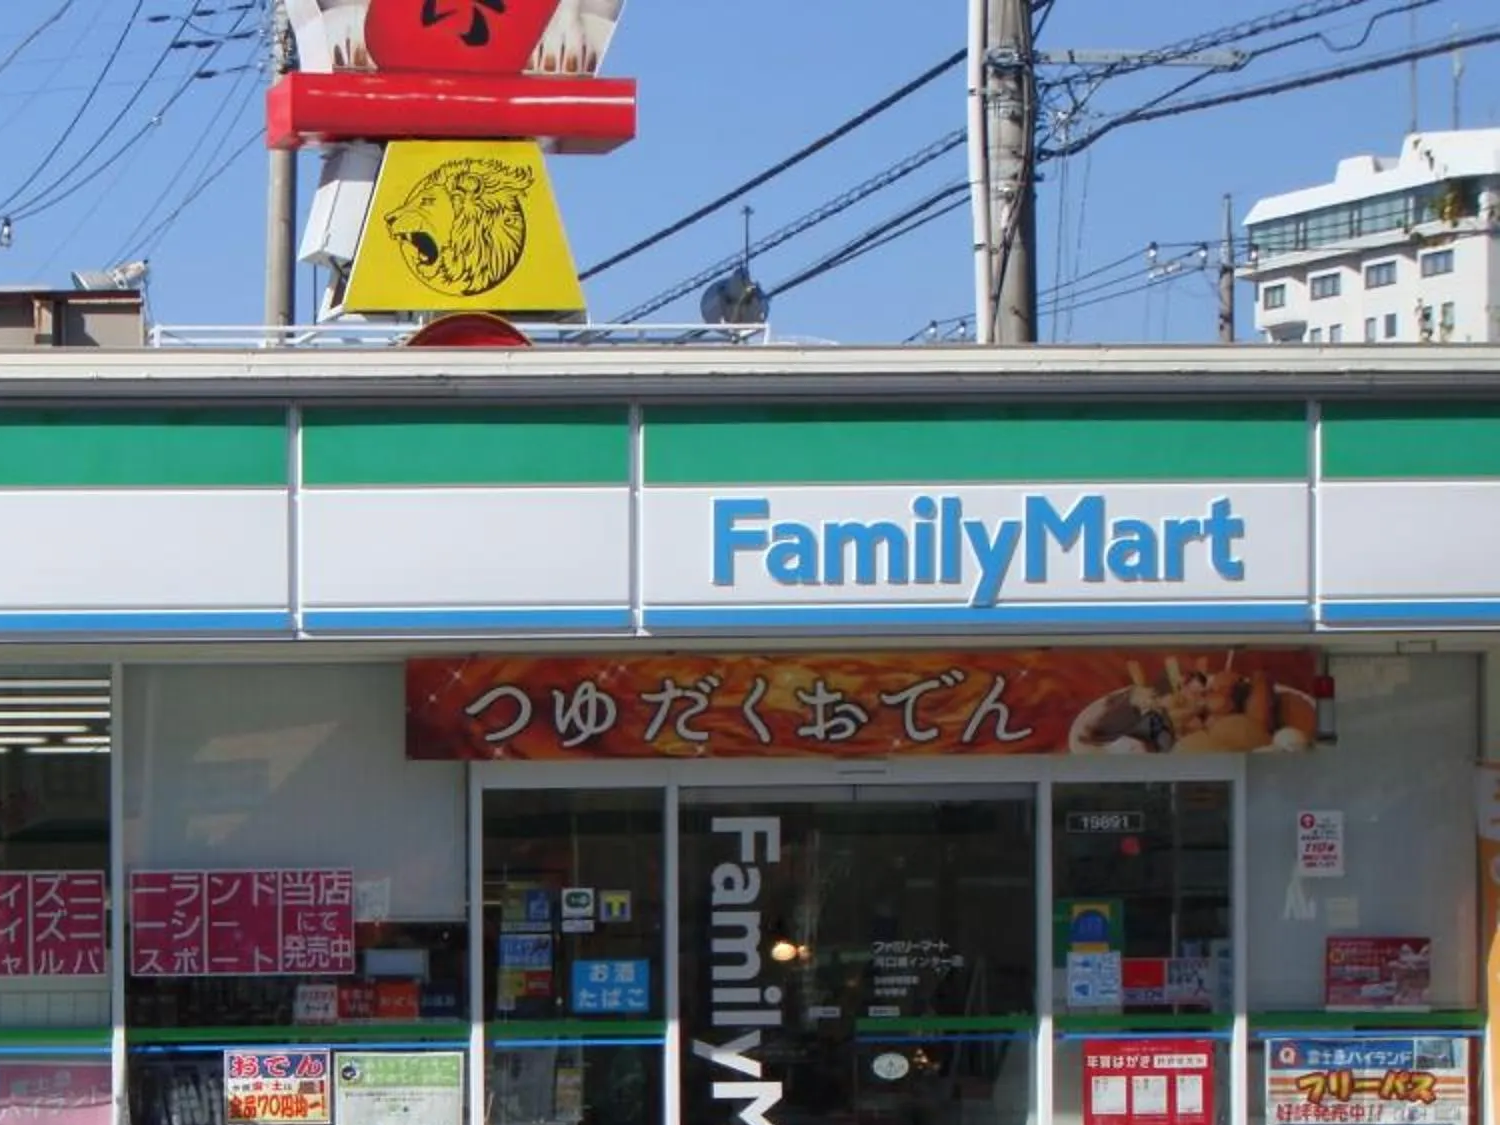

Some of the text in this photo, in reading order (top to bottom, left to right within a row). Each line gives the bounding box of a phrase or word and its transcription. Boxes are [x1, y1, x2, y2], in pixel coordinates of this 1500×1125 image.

[711, 495, 1247, 608] FamilyMart
[464, 668, 1032, 745] つゆだくおでん
[285, 934, 352, 968] 発売中
[577, 988, 646, 1009] たばこ
[231, 1054, 325, 1078] おでん
[1296, 1069, 1438, 1105] フリーパス
